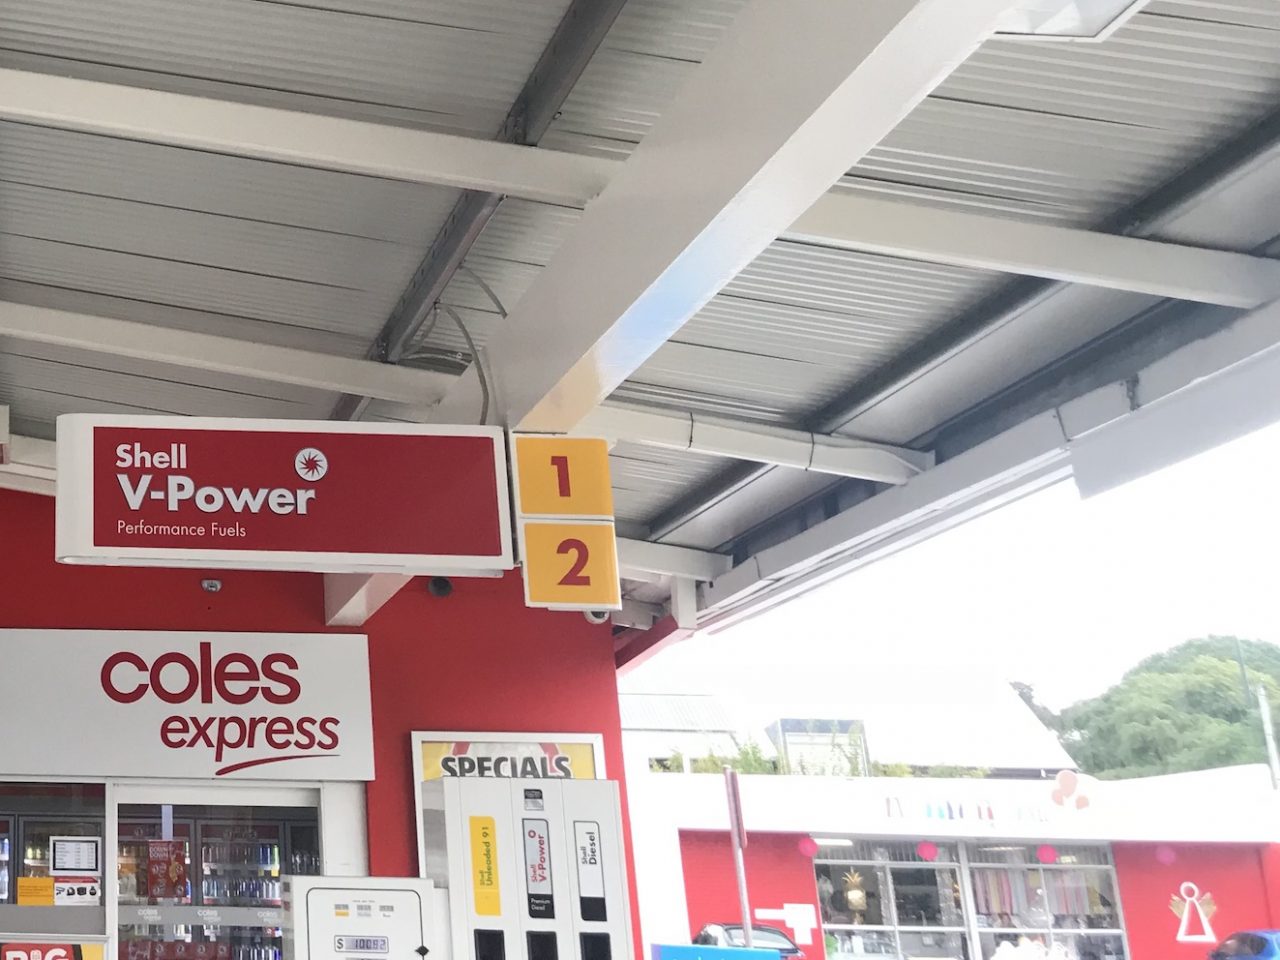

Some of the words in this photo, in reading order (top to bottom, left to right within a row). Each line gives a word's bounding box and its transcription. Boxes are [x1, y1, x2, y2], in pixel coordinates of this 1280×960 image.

[115, 442, 187, 469] Shell
[550, 455, 572, 498] 1
[116, 473, 316, 515] V-Power
[117, 520, 206, 537] Performance
[210, 522, 247, 538] Fuels
[556, 538, 591, 586] 2
[100, 641, 302, 705] coles
[160, 714, 341, 763] express
[441, 756, 571, 778] SPECIALS
[485, 841, 494, 887] Unleaded
[538, 834, 548, 883] V-Power
[586, 831, 598, 865] Diesel
[531, 864, 539, 883] Shell
[530, 898, 551, 906] Premium
